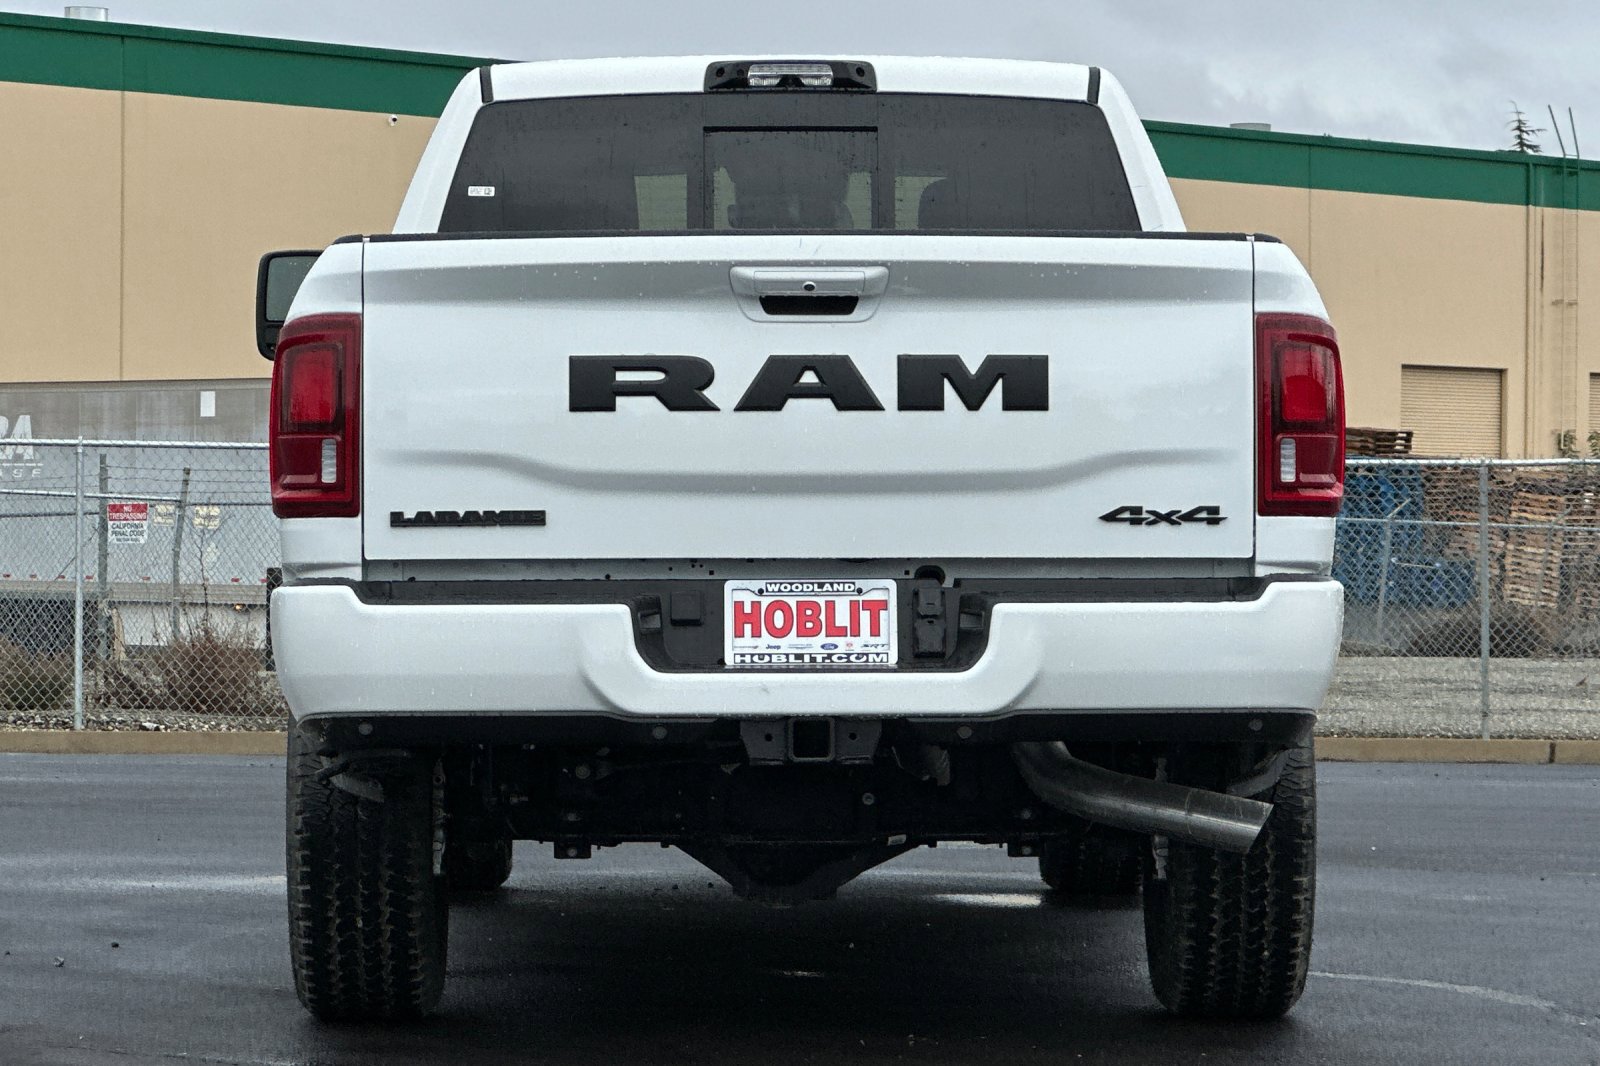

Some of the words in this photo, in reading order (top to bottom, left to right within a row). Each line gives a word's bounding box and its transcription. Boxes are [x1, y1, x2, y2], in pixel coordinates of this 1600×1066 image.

[568, 354, 1049, 411] RAM
[109, 512, 147, 520] TRESPASSING
[1098, 505, 1228, 526] 4x4
[766, 582, 856, 593] WOODLAND
[733, 599, 888, 639] HOBLIT
[765, 643, 782, 651] Jeep
[734, 653, 888, 663] HOBLIT.COM
